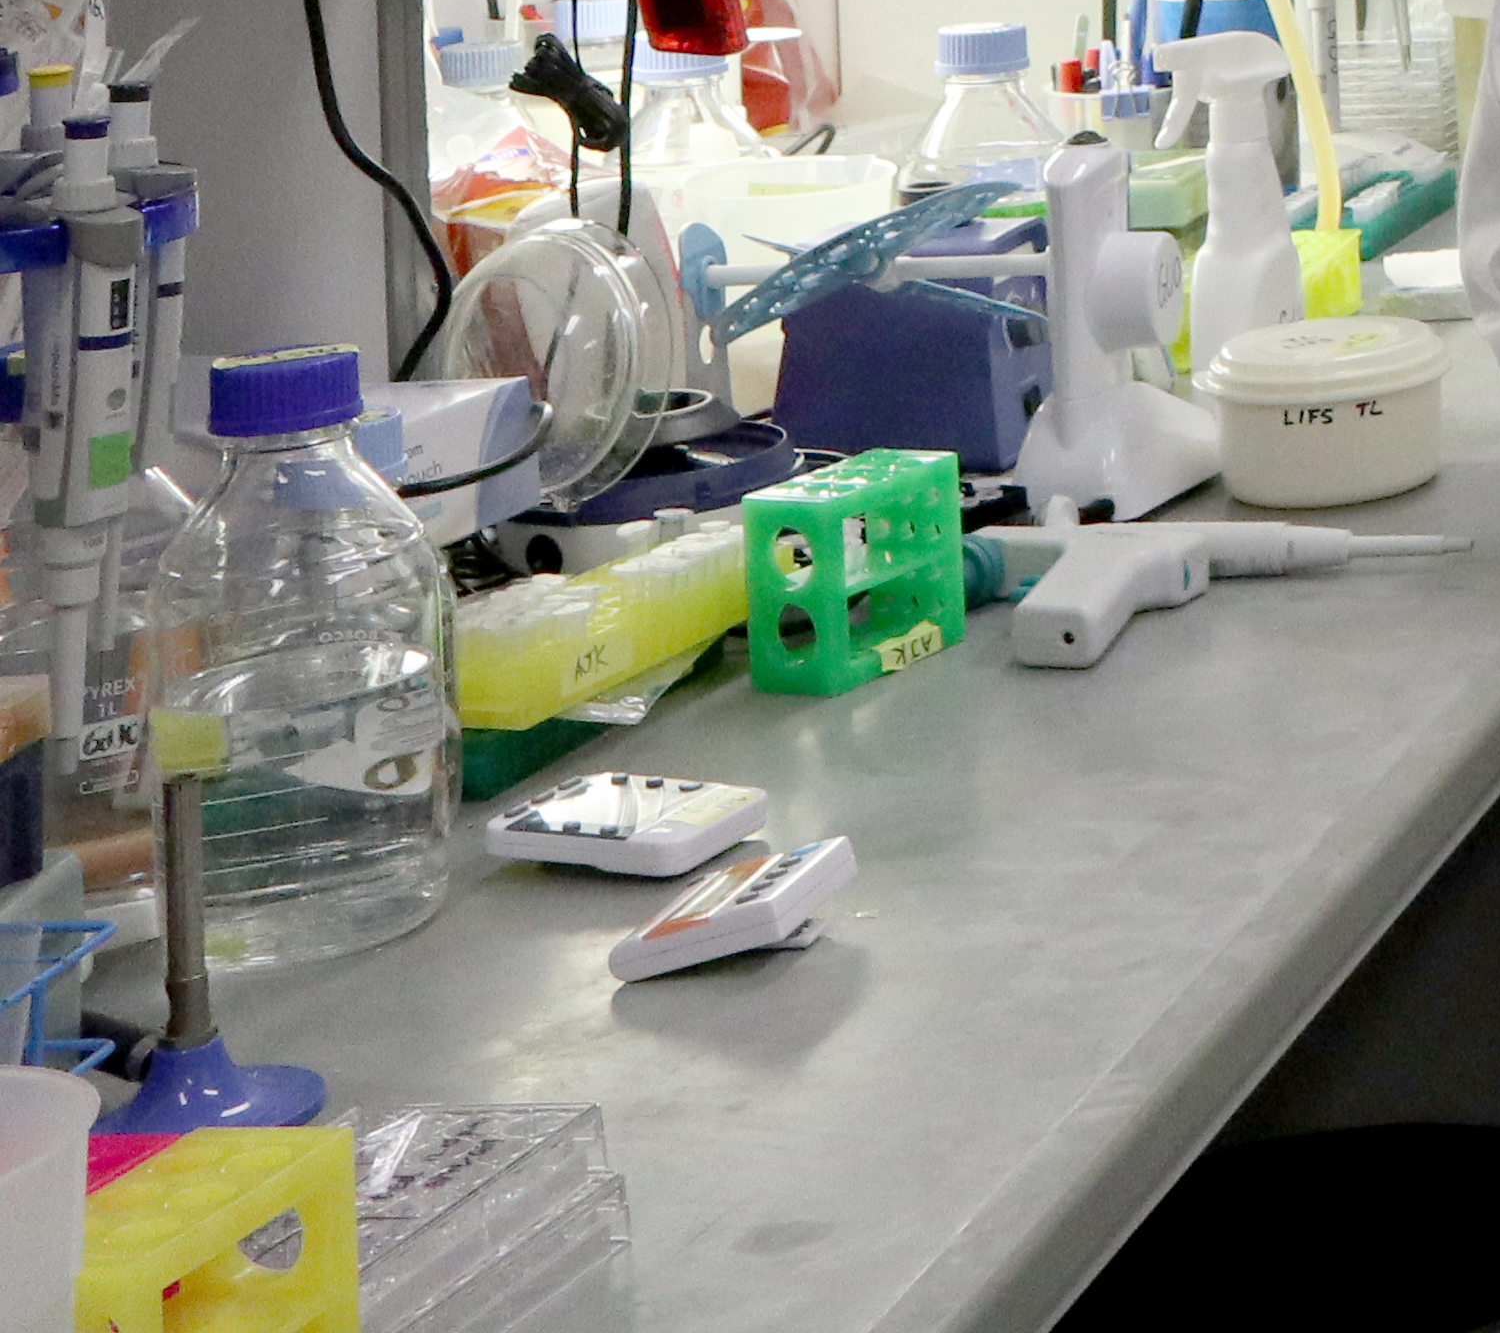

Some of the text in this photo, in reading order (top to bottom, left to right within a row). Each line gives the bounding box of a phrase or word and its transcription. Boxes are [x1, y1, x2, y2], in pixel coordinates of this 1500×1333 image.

[1283, 400, 1384, 426] LIFS TL
[890, 632, 933, 665] AJK
